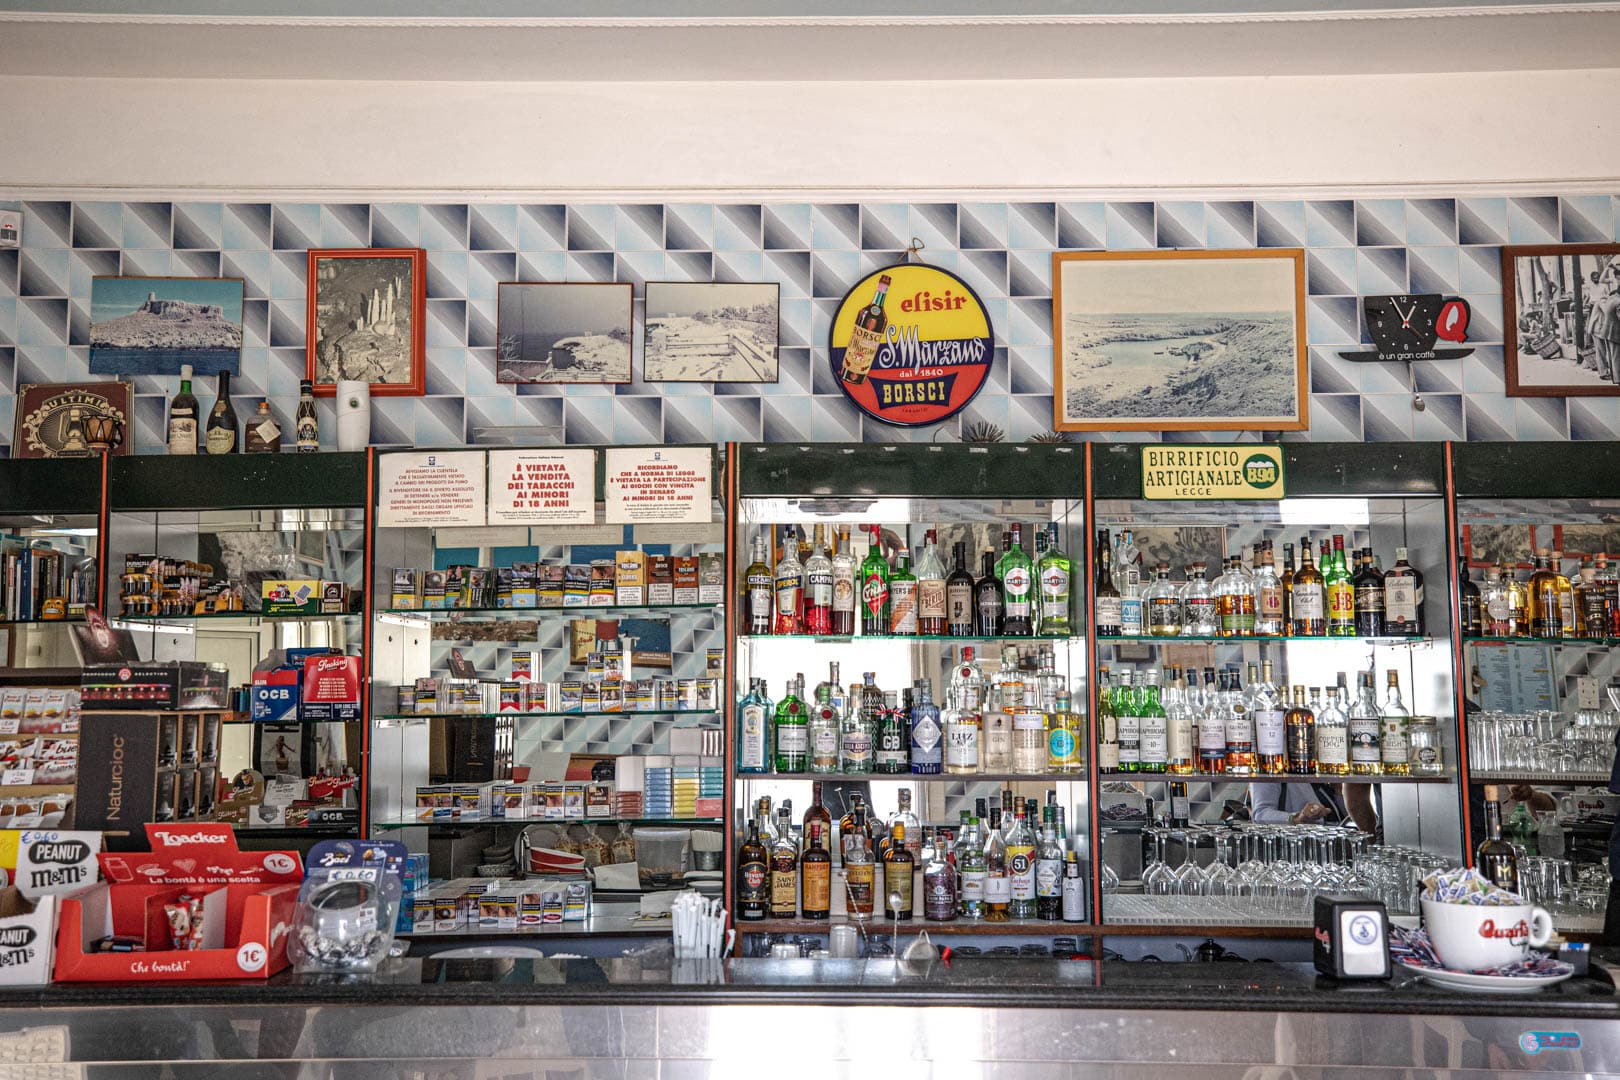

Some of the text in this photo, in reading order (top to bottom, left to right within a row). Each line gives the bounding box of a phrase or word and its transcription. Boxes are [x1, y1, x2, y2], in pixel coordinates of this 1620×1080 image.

[901, 290, 968, 313] elisir
[1436, 301, 1468, 344] Q
[1416, 351, 1436, 359] caffè
[900, 369, 944, 378] dal 1840
[883, 381, 945, 404] BORSCI
[48, 395, 101, 408] ULTIMI
[1150, 451, 1239, 467] BIRRIFICIO
[517, 463, 566, 472] È VIETATA
[528, 473, 570, 481] VENDITA
[1146, 471, 1242, 487] ARTIGIANALE
[527, 482, 575, 490] TABACCHI
[1176, 488, 1212, 496] LECCE
[259, 689, 290, 700] OCB
[883, 736, 900, 750] GB
[106, 735, 125, 821] Naturcioc
[322, 813, 343, 821] OCB
[22, 832, 31, 844] €
[154, 831, 228, 847] Loacker
[36, 844, 83, 860] PEANUT
[320, 852, 352, 866] Baci
[1014, 860, 1026, 870] 51
[165, 876, 196, 884] bontà
[332, 871, 341, 880] €
[0, 929, 30, 946] ANUT
[243, 950, 260, 962] 1€
[131, 962, 149, 974] Che
